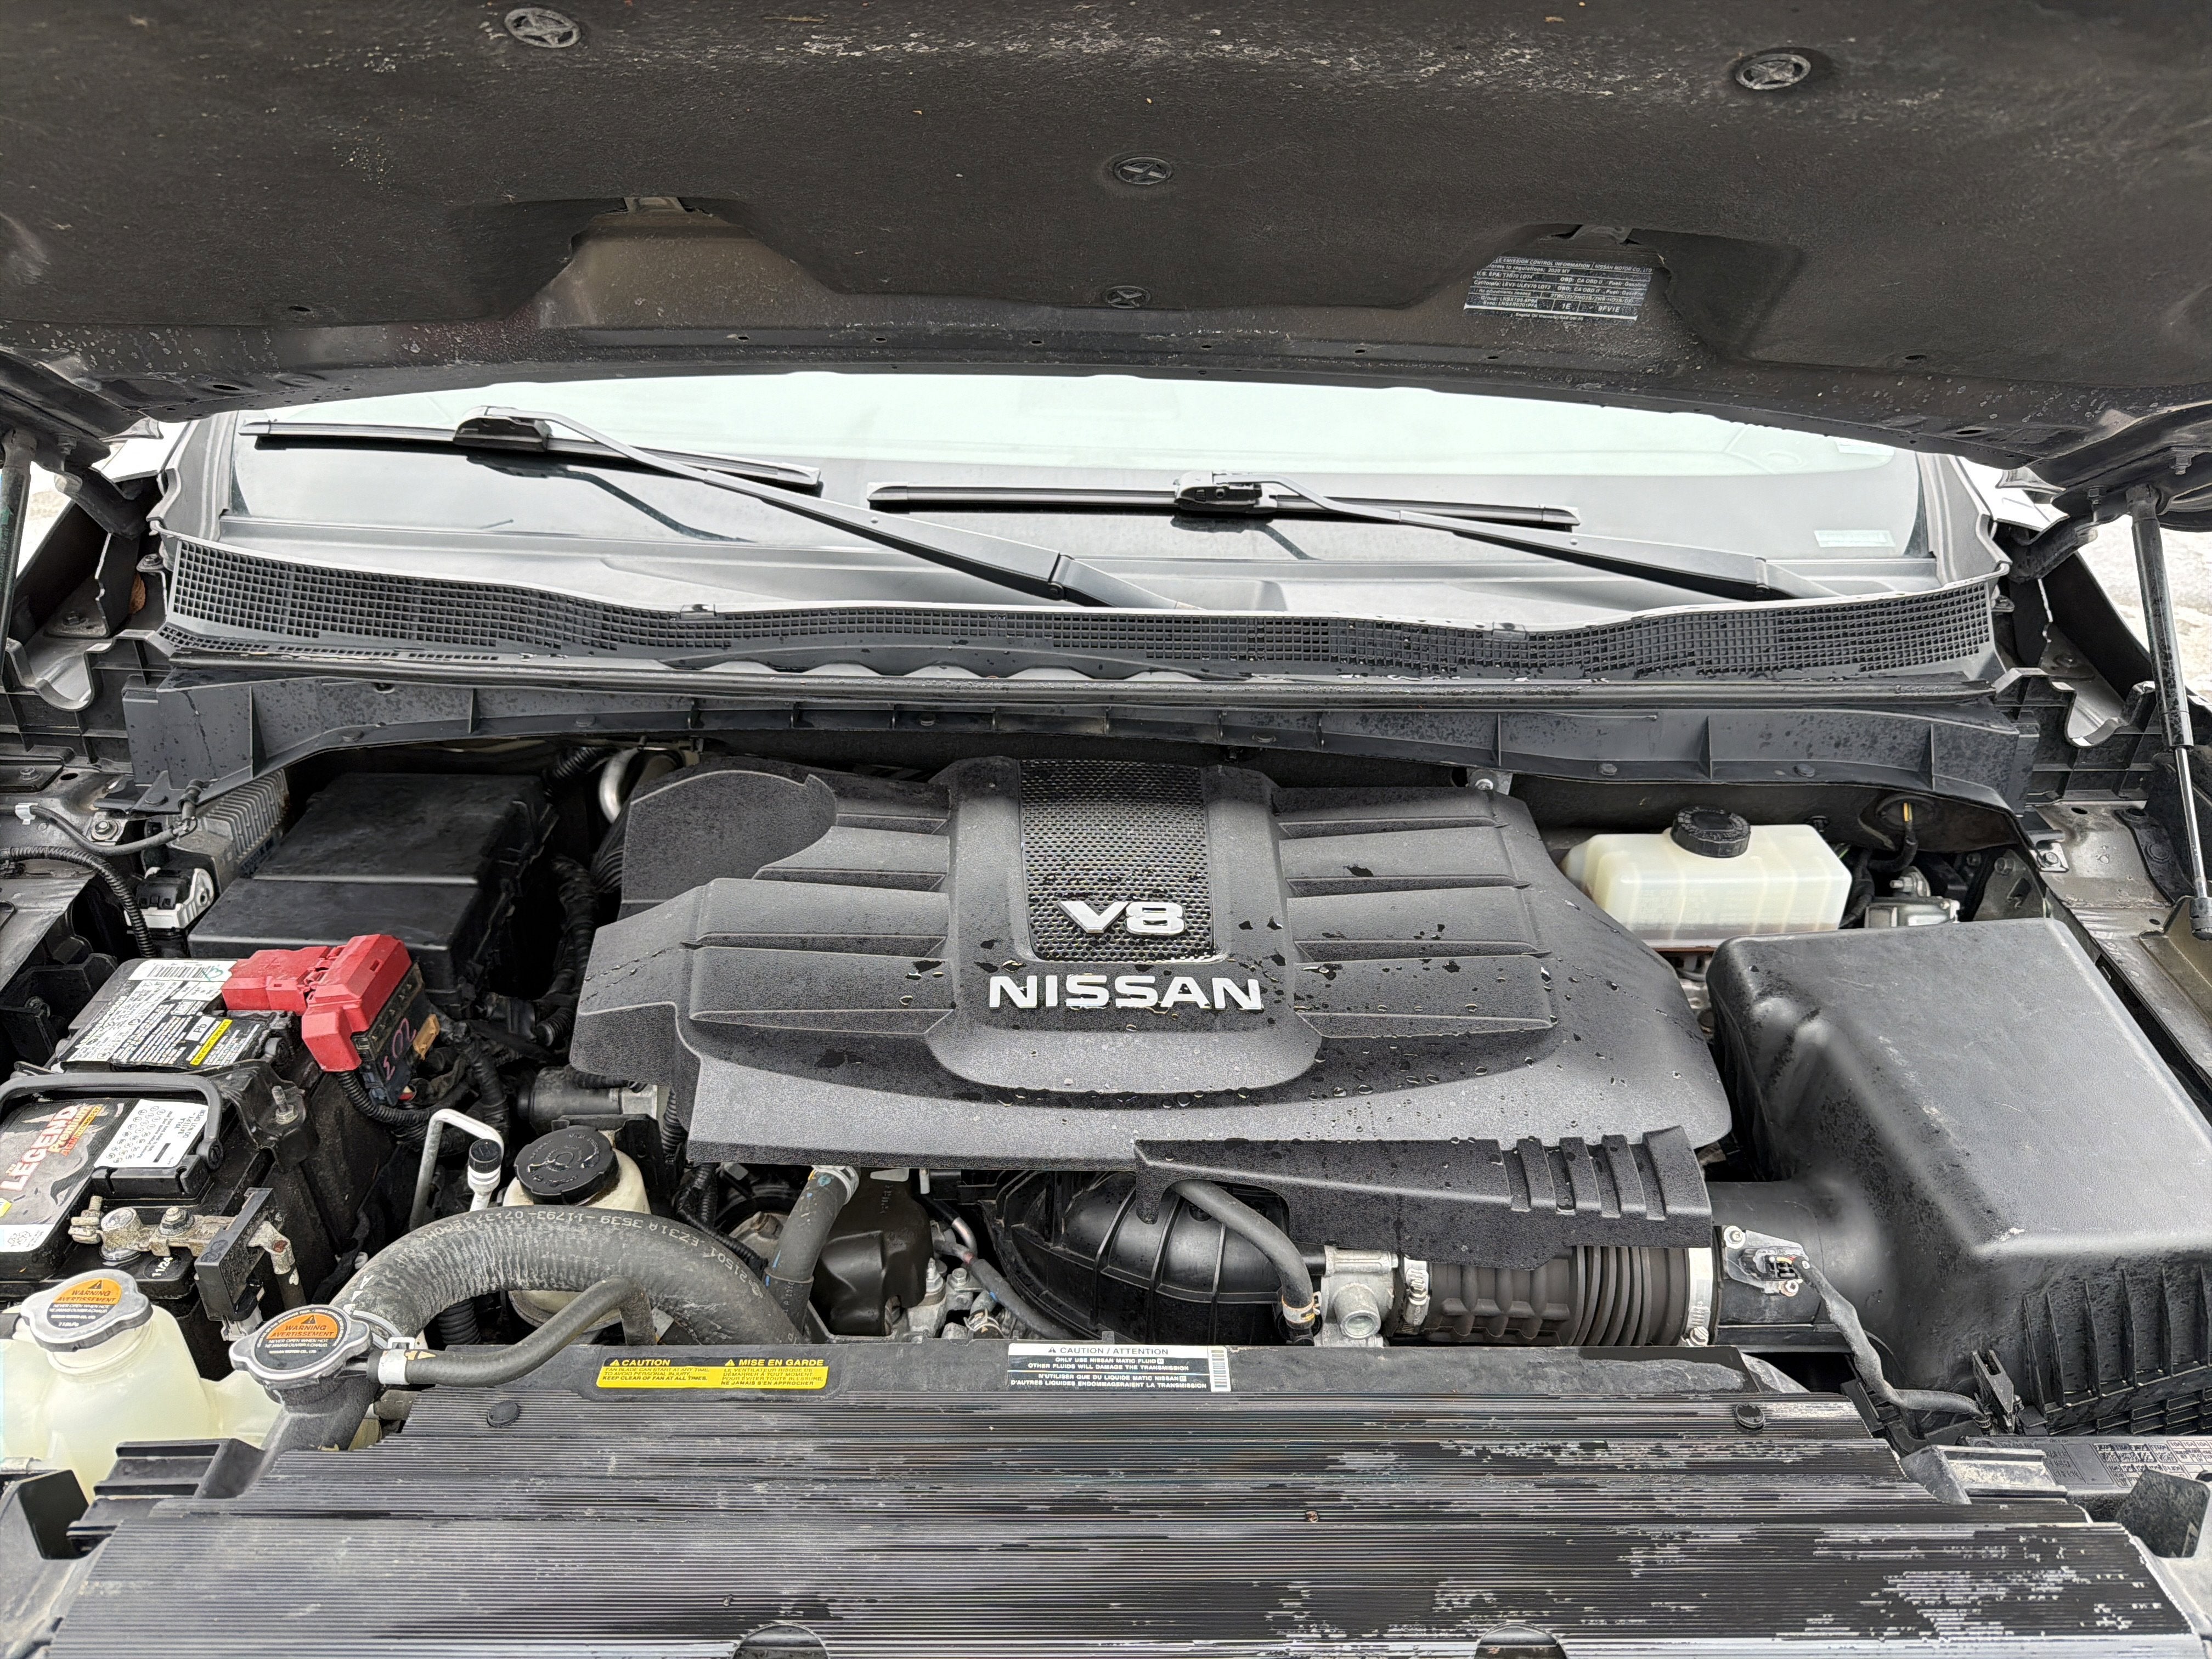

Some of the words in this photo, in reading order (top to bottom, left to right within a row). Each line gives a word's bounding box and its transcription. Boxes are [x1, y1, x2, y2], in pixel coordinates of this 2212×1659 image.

[1059, 900, 1186, 935] V8
[988, 974, 1263, 1011] NISSAN
[193, 1024, 207, 1033] Pb
[47, 1103, 94, 1153] Premium
[0, 1105, 78, 1191] LEGEND
[600, 1215, 644, 1229] 3539
